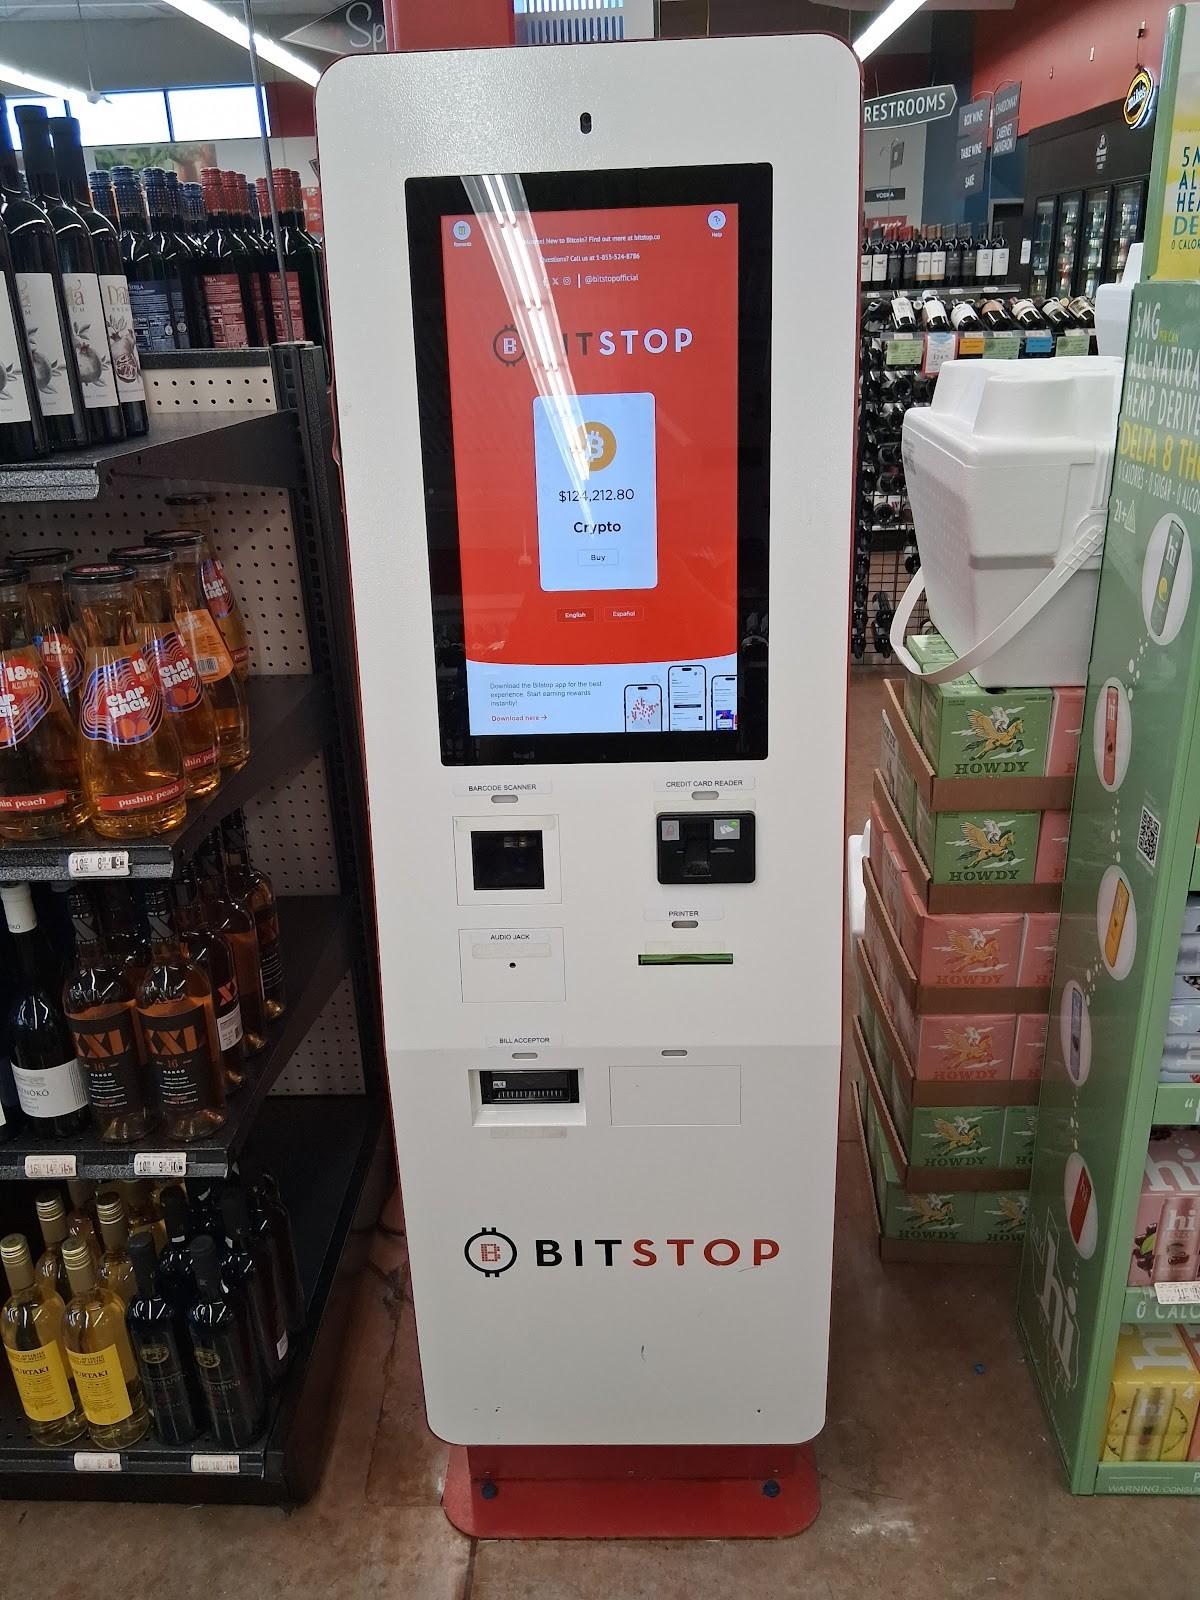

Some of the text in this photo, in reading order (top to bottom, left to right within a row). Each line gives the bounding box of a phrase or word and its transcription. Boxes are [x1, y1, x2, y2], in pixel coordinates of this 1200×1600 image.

[864, 93, 946, 122] RESTROOMS
[585, 274, 639, 284] @bitstopofficial
[1134, 301, 1162, 342] 5MG
[562, 328, 693, 356] ITSTOP
[1125, 381, 1155, 423] HEMP
[1119, 420, 1158, 468] DELTA
[1163, 434, 1174, 472] 8
[558, 488, 635, 504] $124,212.80
[573, 521, 622, 535] Crypto
[590, 554, 606, 562] Buy
[565, 611, 587, 619] English
[6, 665, 38, 682] 18%
[160, 658, 190, 678] CLAP
[163, 666, 196, 688] BACK
[106, 686, 145, 708] CLAP
[108, 695, 150, 719] BACK
[954, 760, 1029, 775] HOWDY
[468, 784, 537, 792] BARCODE SCANNER
[15, 797, 46, 808] peach
[118, 785, 180, 808] pushin' peach
[948, 870, 1020, 882] HOWDY
[936, 974, 1004, 985] HOWDY
[932, 1070, 998, 1081] HOWDY
[924, 1156, 987, 1168] HOWDY
[1166, 1209, 1197, 1231] hi
[898, 1230, 960, 1242] HOWDY
[535, 1238, 780, 1267] BITSTOP
[1183, 1384, 1195, 1400] 4
